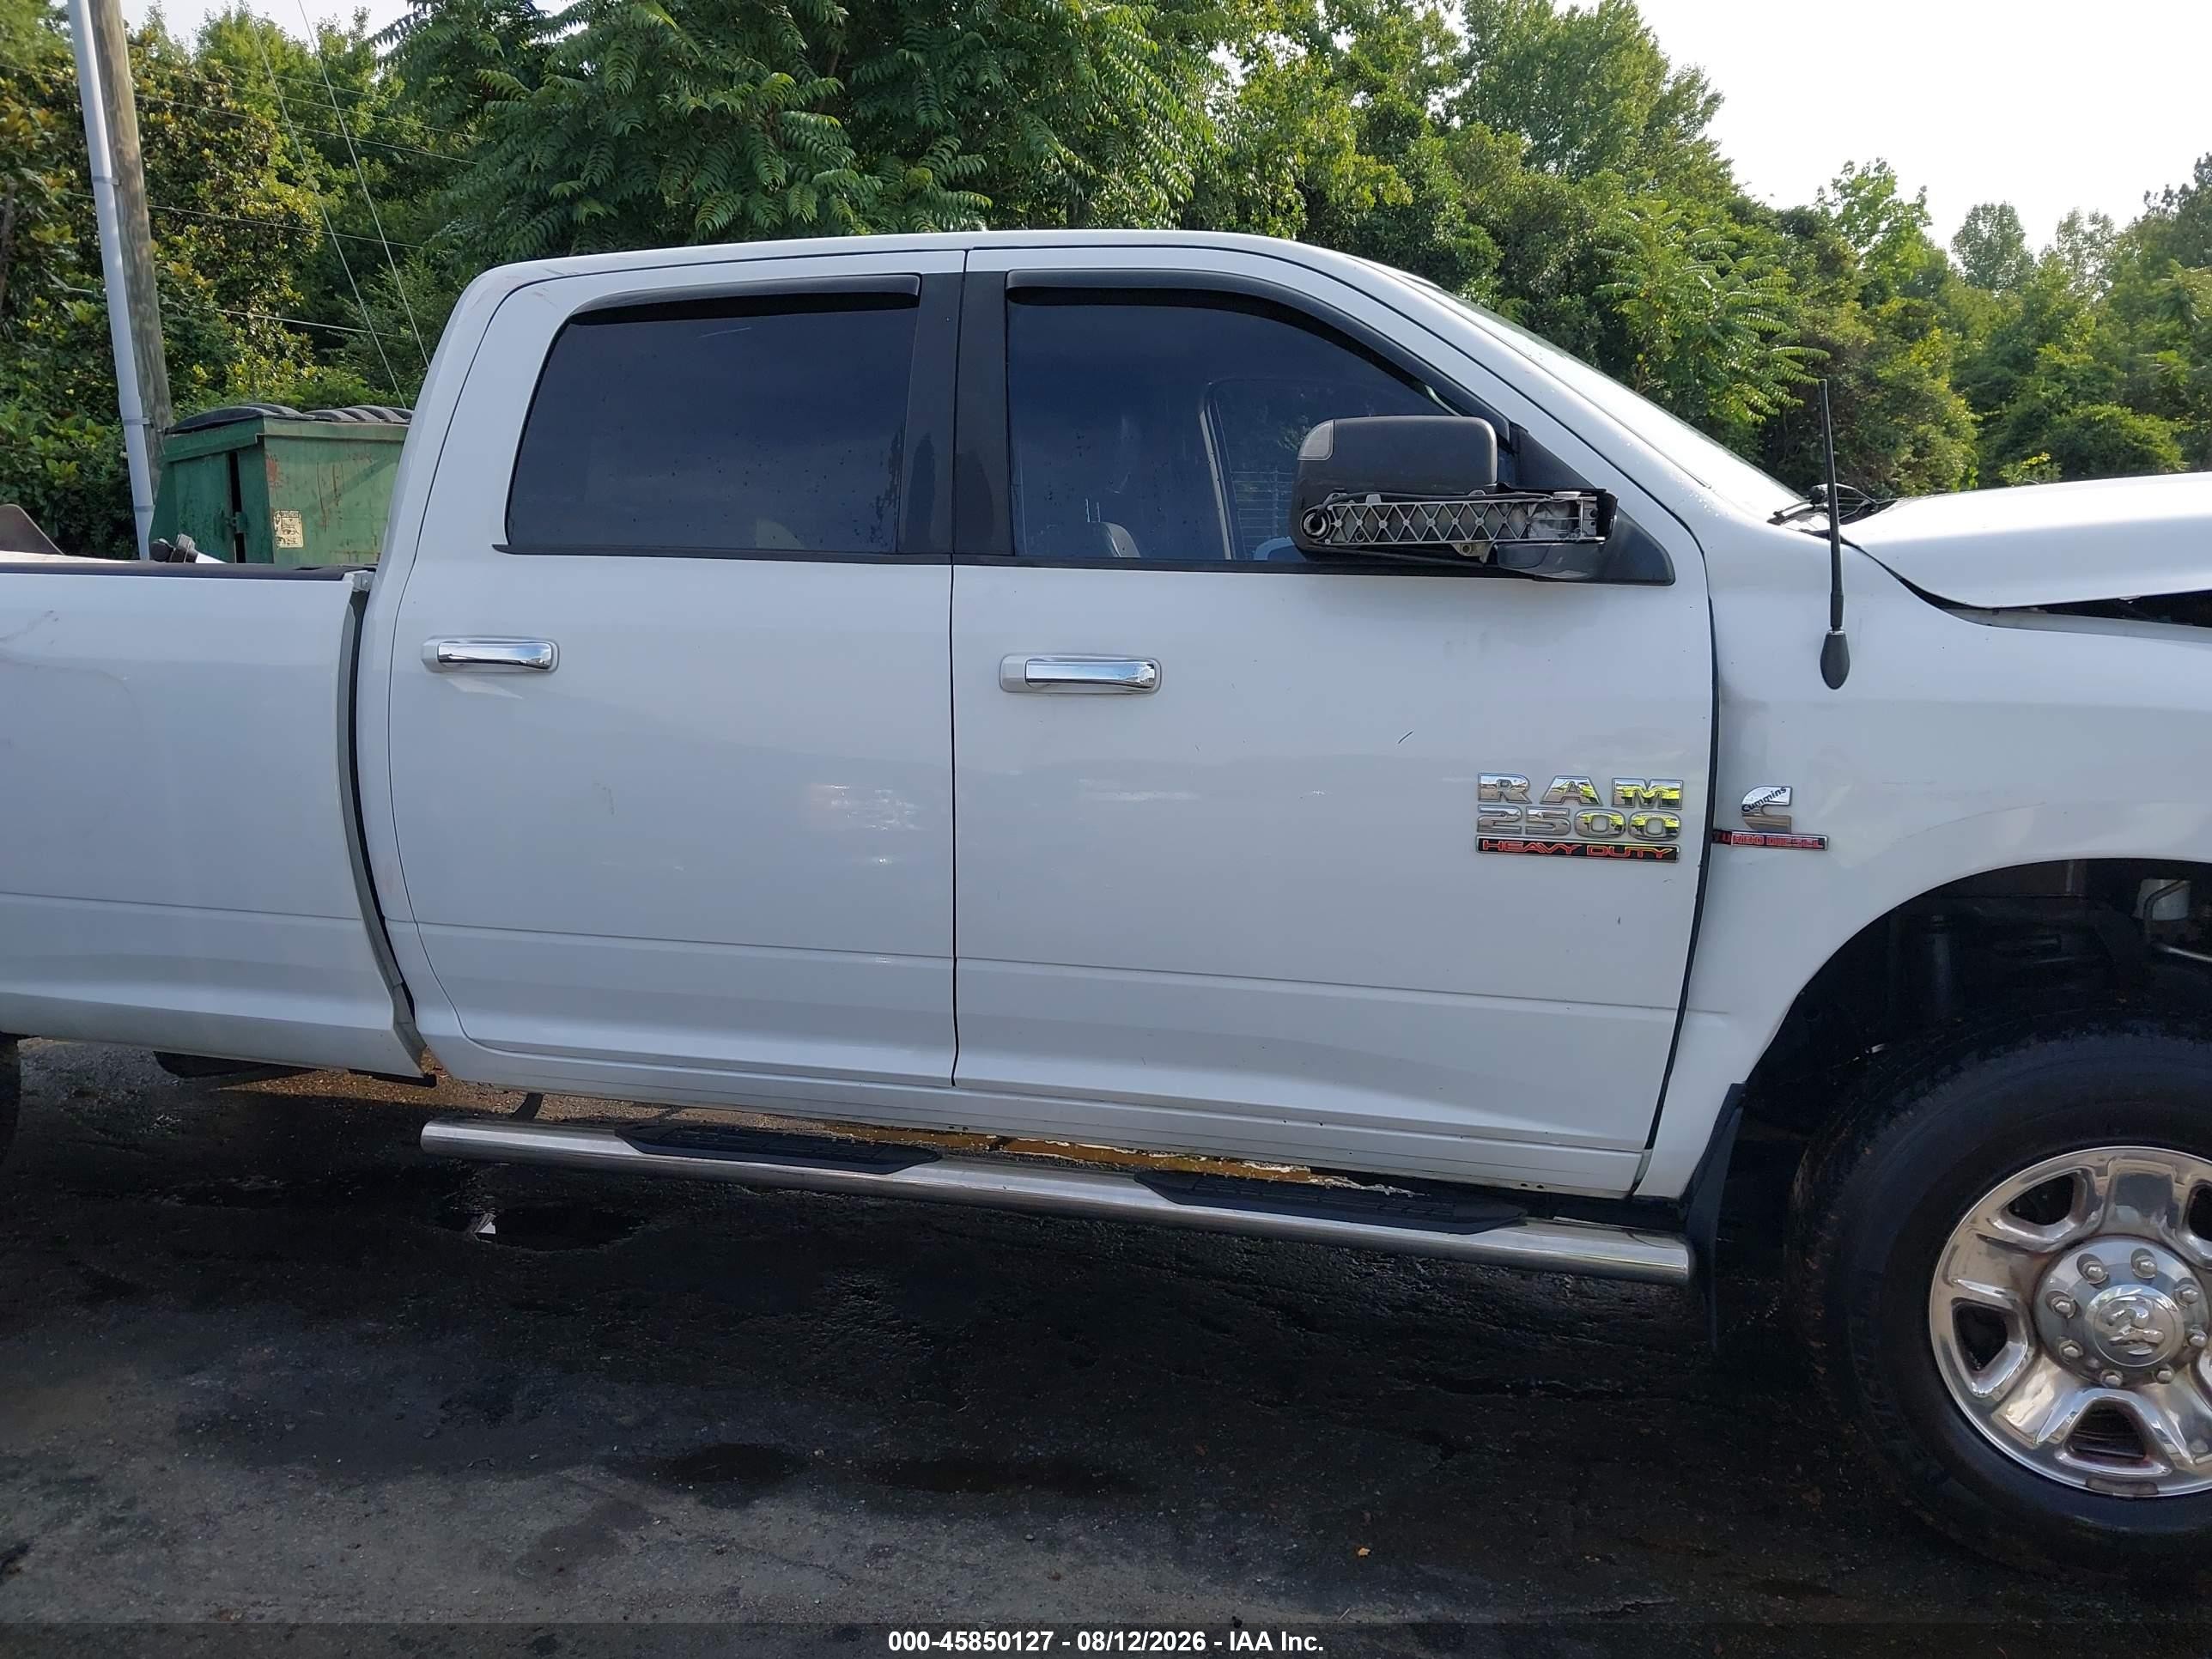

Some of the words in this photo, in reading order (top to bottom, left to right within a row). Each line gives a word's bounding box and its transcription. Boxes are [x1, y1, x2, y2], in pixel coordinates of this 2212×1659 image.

[1478, 773, 1683, 810] RAM
[1741, 787, 1787, 812] Cummins
[1477, 805, 1681, 842] 2500
[1482, 840, 1582, 854] HEAVY
[1586, 845, 1674, 859] DUTY
[1766, 836, 1823, 848] DIESEL
